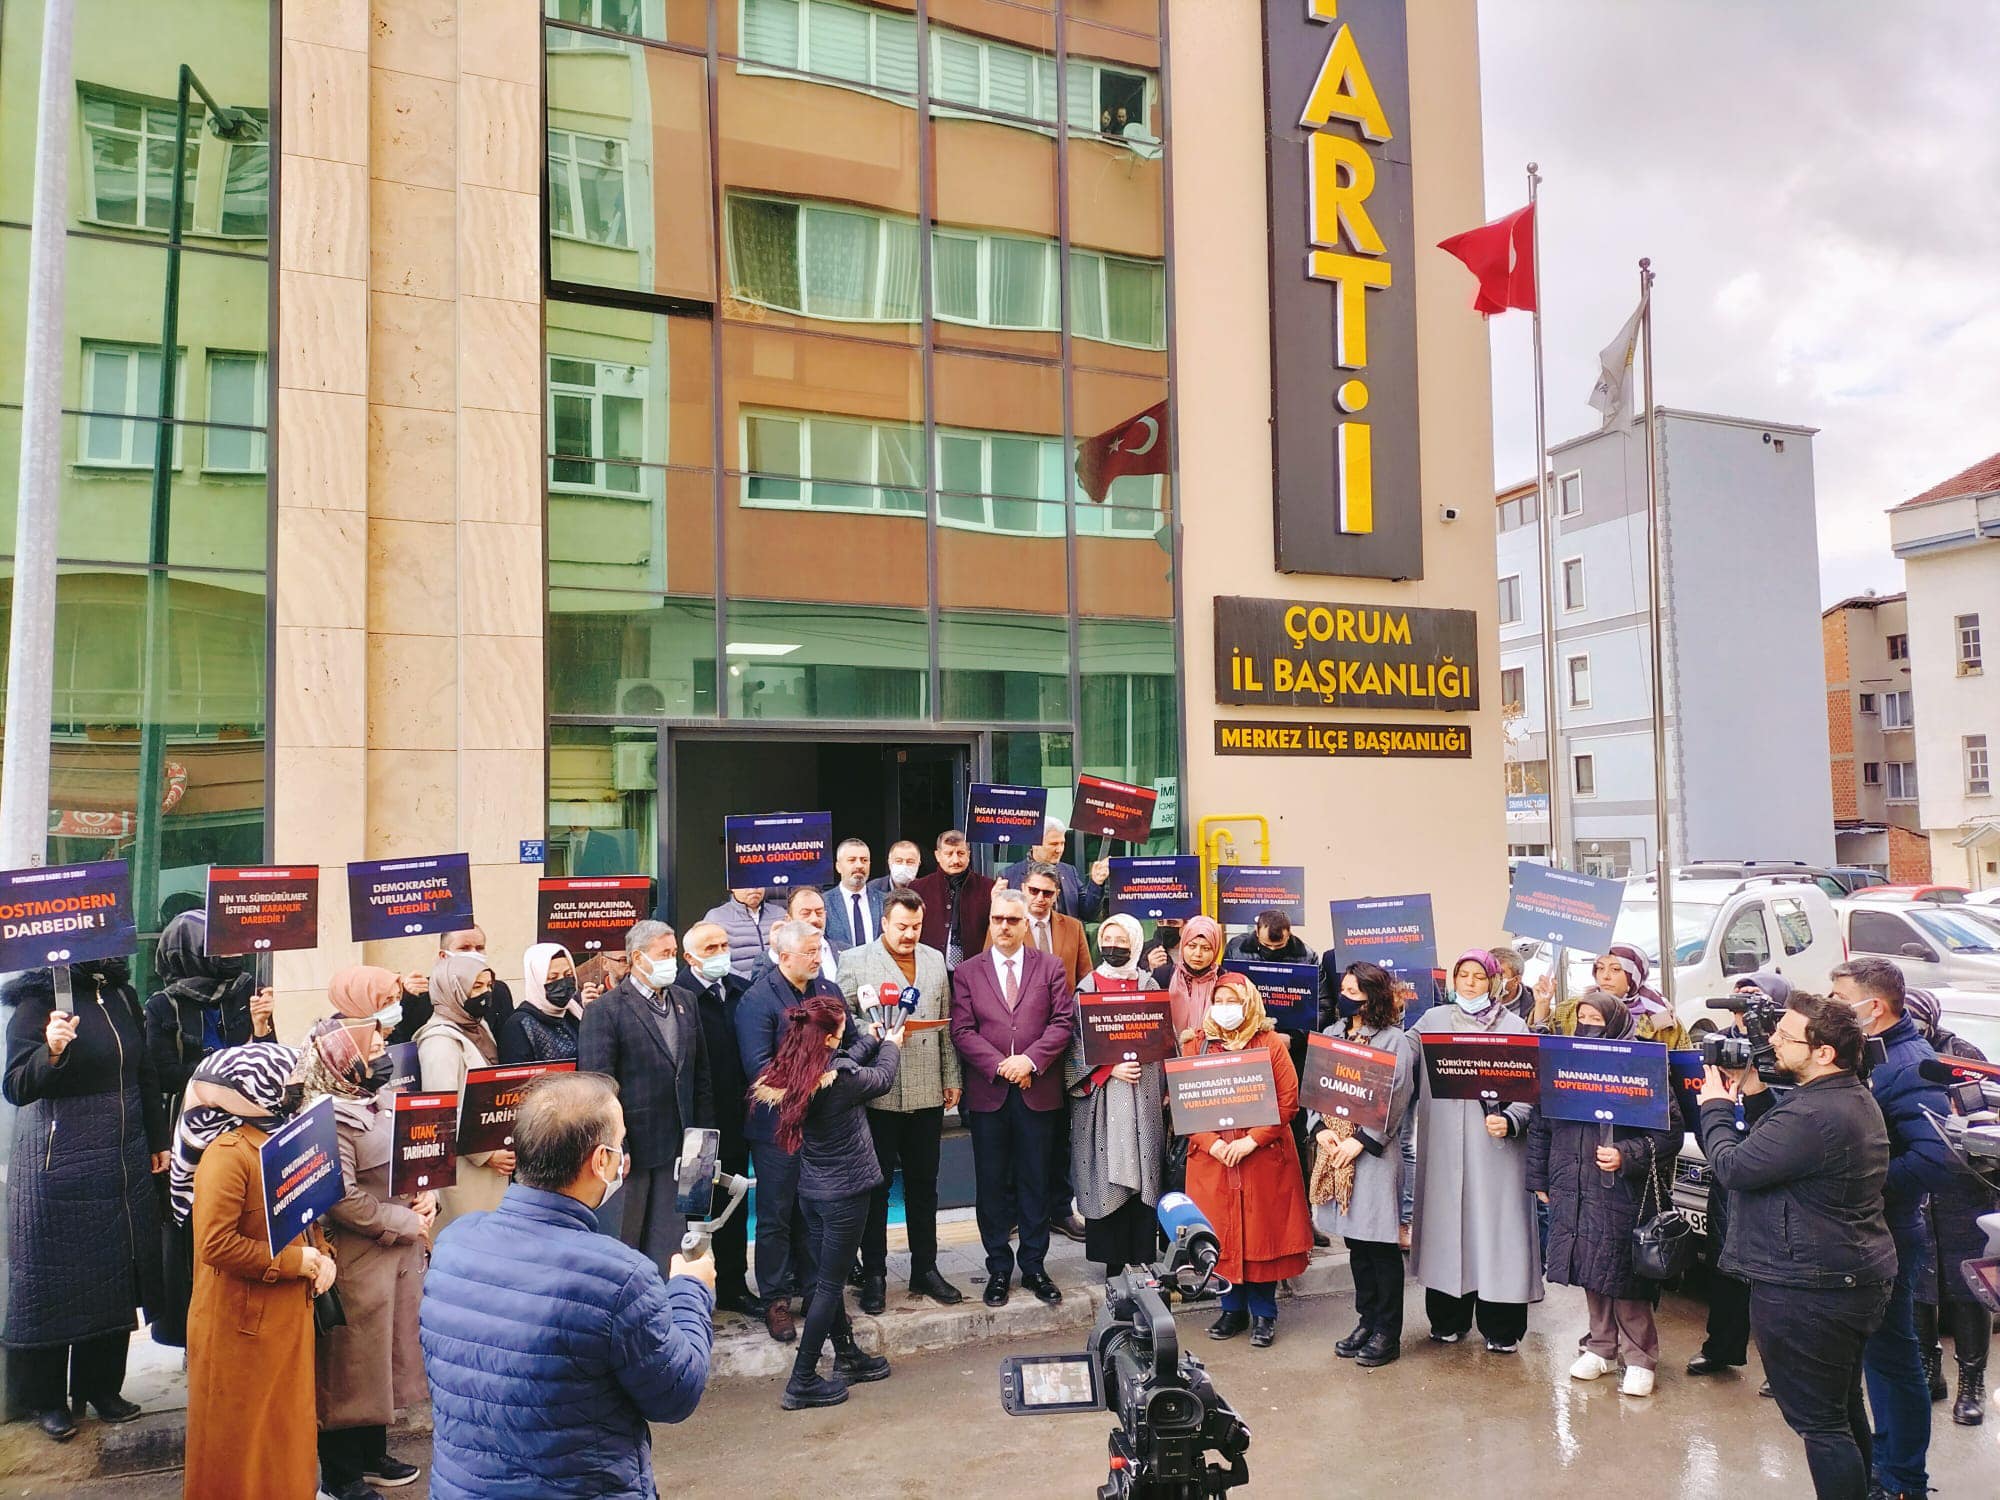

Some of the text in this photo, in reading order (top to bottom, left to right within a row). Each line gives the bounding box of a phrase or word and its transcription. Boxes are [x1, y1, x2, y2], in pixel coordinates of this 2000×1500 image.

[1300, 0, 1392, 534] ARTİ
[1284, 605, 1412, 649] ÇORUM
[1232, 647, 1470, 703] İL BAŞKANLIĞI
[1222, 725, 1465, 755] MERKEZ İLÇE BAŞKANLIĞI
[974, 805, 1040, 817] İNSAN HAKLARININ
[996, 817, 1032, 826] GÜNÜDÜR
[525, 847, 539, 856] 24
[736, 841, 823, 853] İNSAN HAKLARININ
[739, 855, 764, 864] KARA
[766, 850, 814, 862] GÜNÜDÜR
[373, 877, 448, 893] DEMOKRASİYE
[1123, 883, 1183, 892] UNUTMAYACAĞIZ
[219, 891, 308, 904] BİN YIL SÜRDÜRÜLMEK
[369, 889, 453, 905] VURULAN KARA
[1117, 891, 1189, 900] UNUTTURMAYACAĞIZ
[0, 893, 116, 919] OSTMODERN
[226, 903, 301, 914] İSTENEN KARANLIK
[387, 902, 430, 915] LEKEDİR
[553, 901, 633, 910] OKUL KAPILARINDA,
[241, 914, 280, 925] DARBEDİR
[550, 909, 636, 920] MİLLETİN MECLİSİNDE
[4, 913, 94, 939] DARBEDİR
[547, 921, 580, 929] KIRILAN
[582, 919, 634, 928] ONURLARDIR
[1347, 925, 1419, 936] İNANANLARA KARŞI
[1344, 937, 1383, 945] TOPYEKUN
[1385, 934, 1419, 944] SAVAŞTIR
[1287, 987, 1311, 995] ISRARLA
[1089, 1014, 1101, 1023] BİN
[1114, 1012, 1164, 1022] SÜRDÜRÜLMEK
[1095, 1022, 1159, 1032] İSTENEN KARANLIK
[1109, 1031, 1143, 1040] DARBEDİR
[1436, 1057, 1533, 1070] TÜRKİYE'NİN AYAĞINA
[1335, 1062, 1361, 1081] İKNA
[1436, 1067, 1478, 1075] VURULAN
[1480, 1069, 1530, 1078] PRANGADIR
[1558, 1068, 1648, 1087] İNANANLARA KARŞI
[1179, 1074, 1263, 1090] DEMOKRASİYE BALANS
[1320, 1076, 1367, 1099] OLMADIK
[1554, 1080, 1602, 1092] TOPYEKUN
[1604, 1084, 1648, 1097] SAVAŞTIR
[1179, 1083, 1266, 1100] AYARI KILIFIYLA MİLLETE
[1183, 1099, 1220, 1109] VURULAN
[1222, 1094, 1258, 1105] DARBEDİR
[480, 1108, 517, 1125] TARİH
[411, 1125, 437, 1142] UTANÇ
[403, 1142, 440, 1160] TARİHİDİR
[281, 1146, 315, 1179] UNUTMADIK
[276, 1153, 324, 1199] UNUTMAYACAĞIZ
[273, 1163, 331, 1216] UNUTTURMAYACAĞIZ
